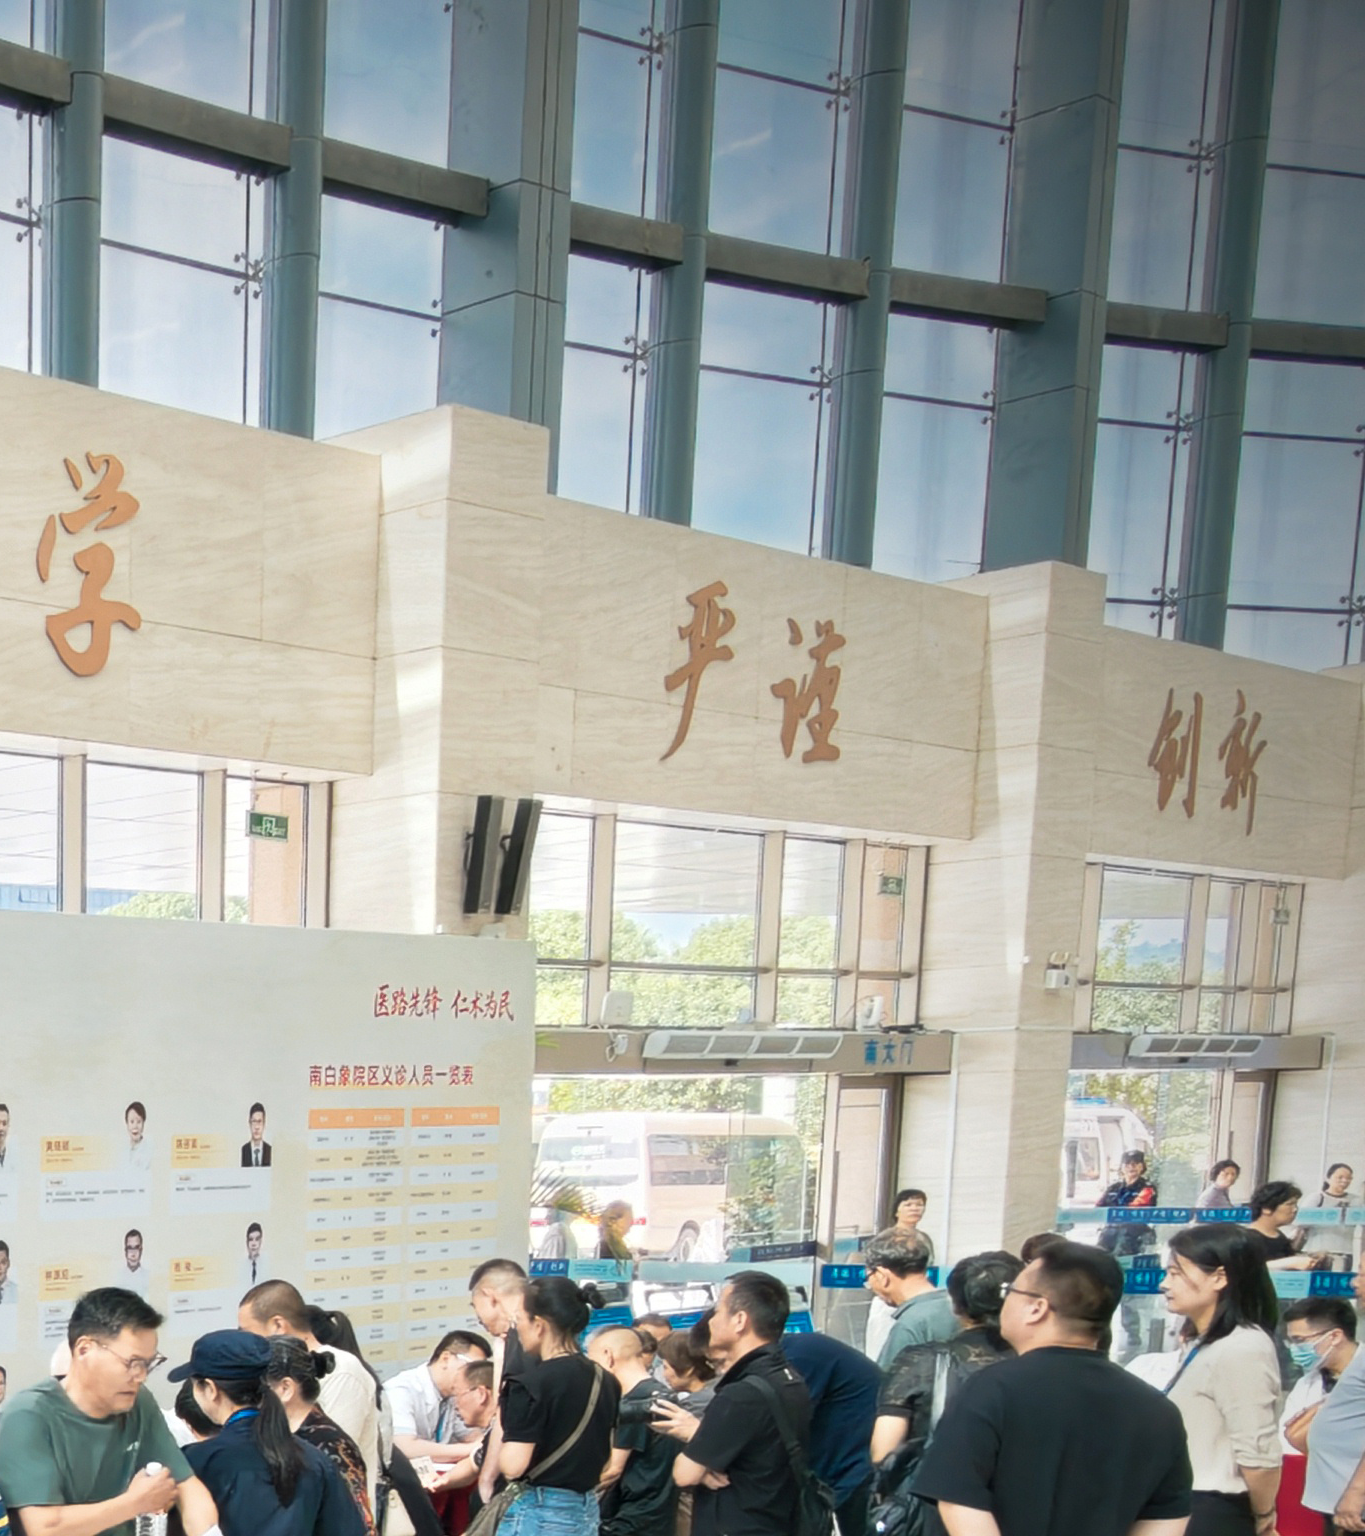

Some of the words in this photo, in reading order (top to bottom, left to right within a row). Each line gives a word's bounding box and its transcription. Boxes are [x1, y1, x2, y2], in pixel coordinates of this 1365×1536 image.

[660, 580, 846, 764] 严谨
[1147, 687, 1267, 836] 创新
[374, 984, 443, 1021] 医路先锋
[451, 989, 515, 1022] 仁术为民
[309, 1064, 474, 1087] 南白象院区义诊人员一览表
